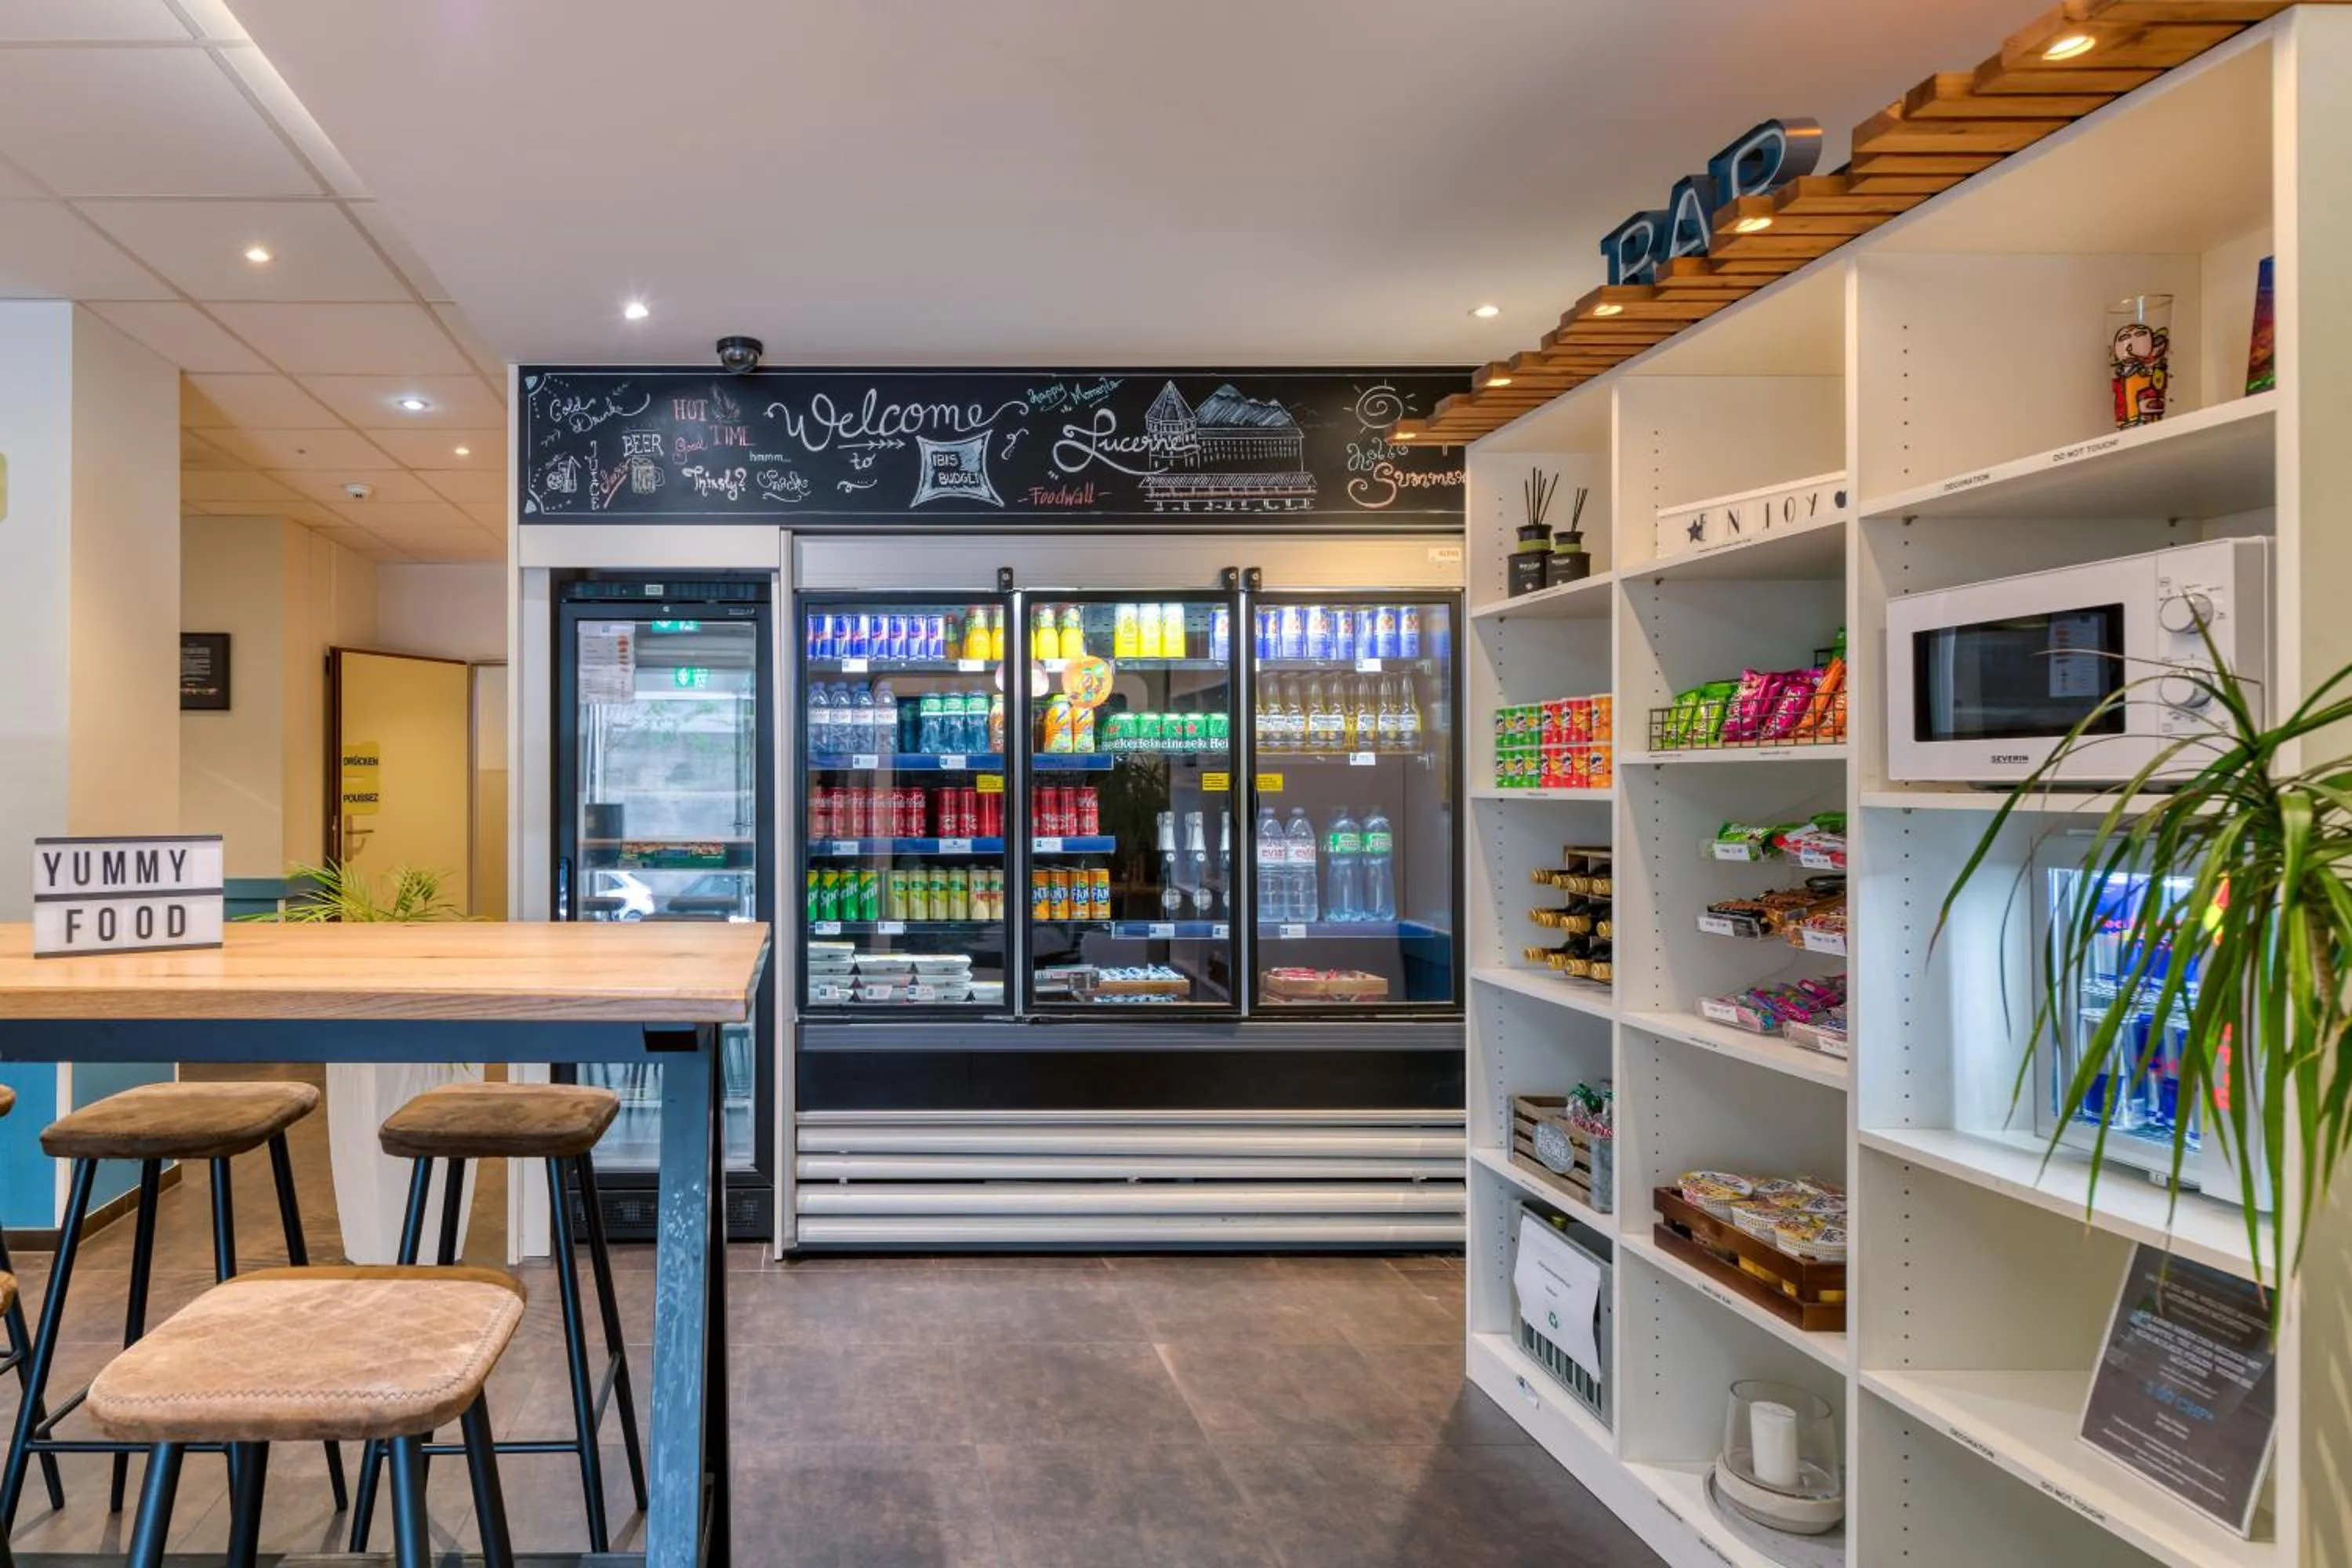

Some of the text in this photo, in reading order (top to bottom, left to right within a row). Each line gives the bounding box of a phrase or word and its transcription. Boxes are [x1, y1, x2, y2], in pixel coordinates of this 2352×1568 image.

[550, 398, 596, 423] Cold
[673, 399, 708, 422] HOT
[764, 389, 1029, 452] Welcome
[622, 433, 664, 457] BEER
[709, 425, 757, 446] TIME
[1053, 408, 1201, 475] Lucerne
[850, 452, 876, 470] to
[931, 453, 958, 466] IBIS
[2053, 453, 2066, 462] DO
[2067, 448, 2084, 459] NOT
[938, 472, 979, 485] BUDGET
[1029, 480, 1094, 506] Foodwall
[1991, 755, 2029, 764] SEVERIN
[43, 849, 186, 886] YUMMY
[66, 905, 186, 943] FOOD
